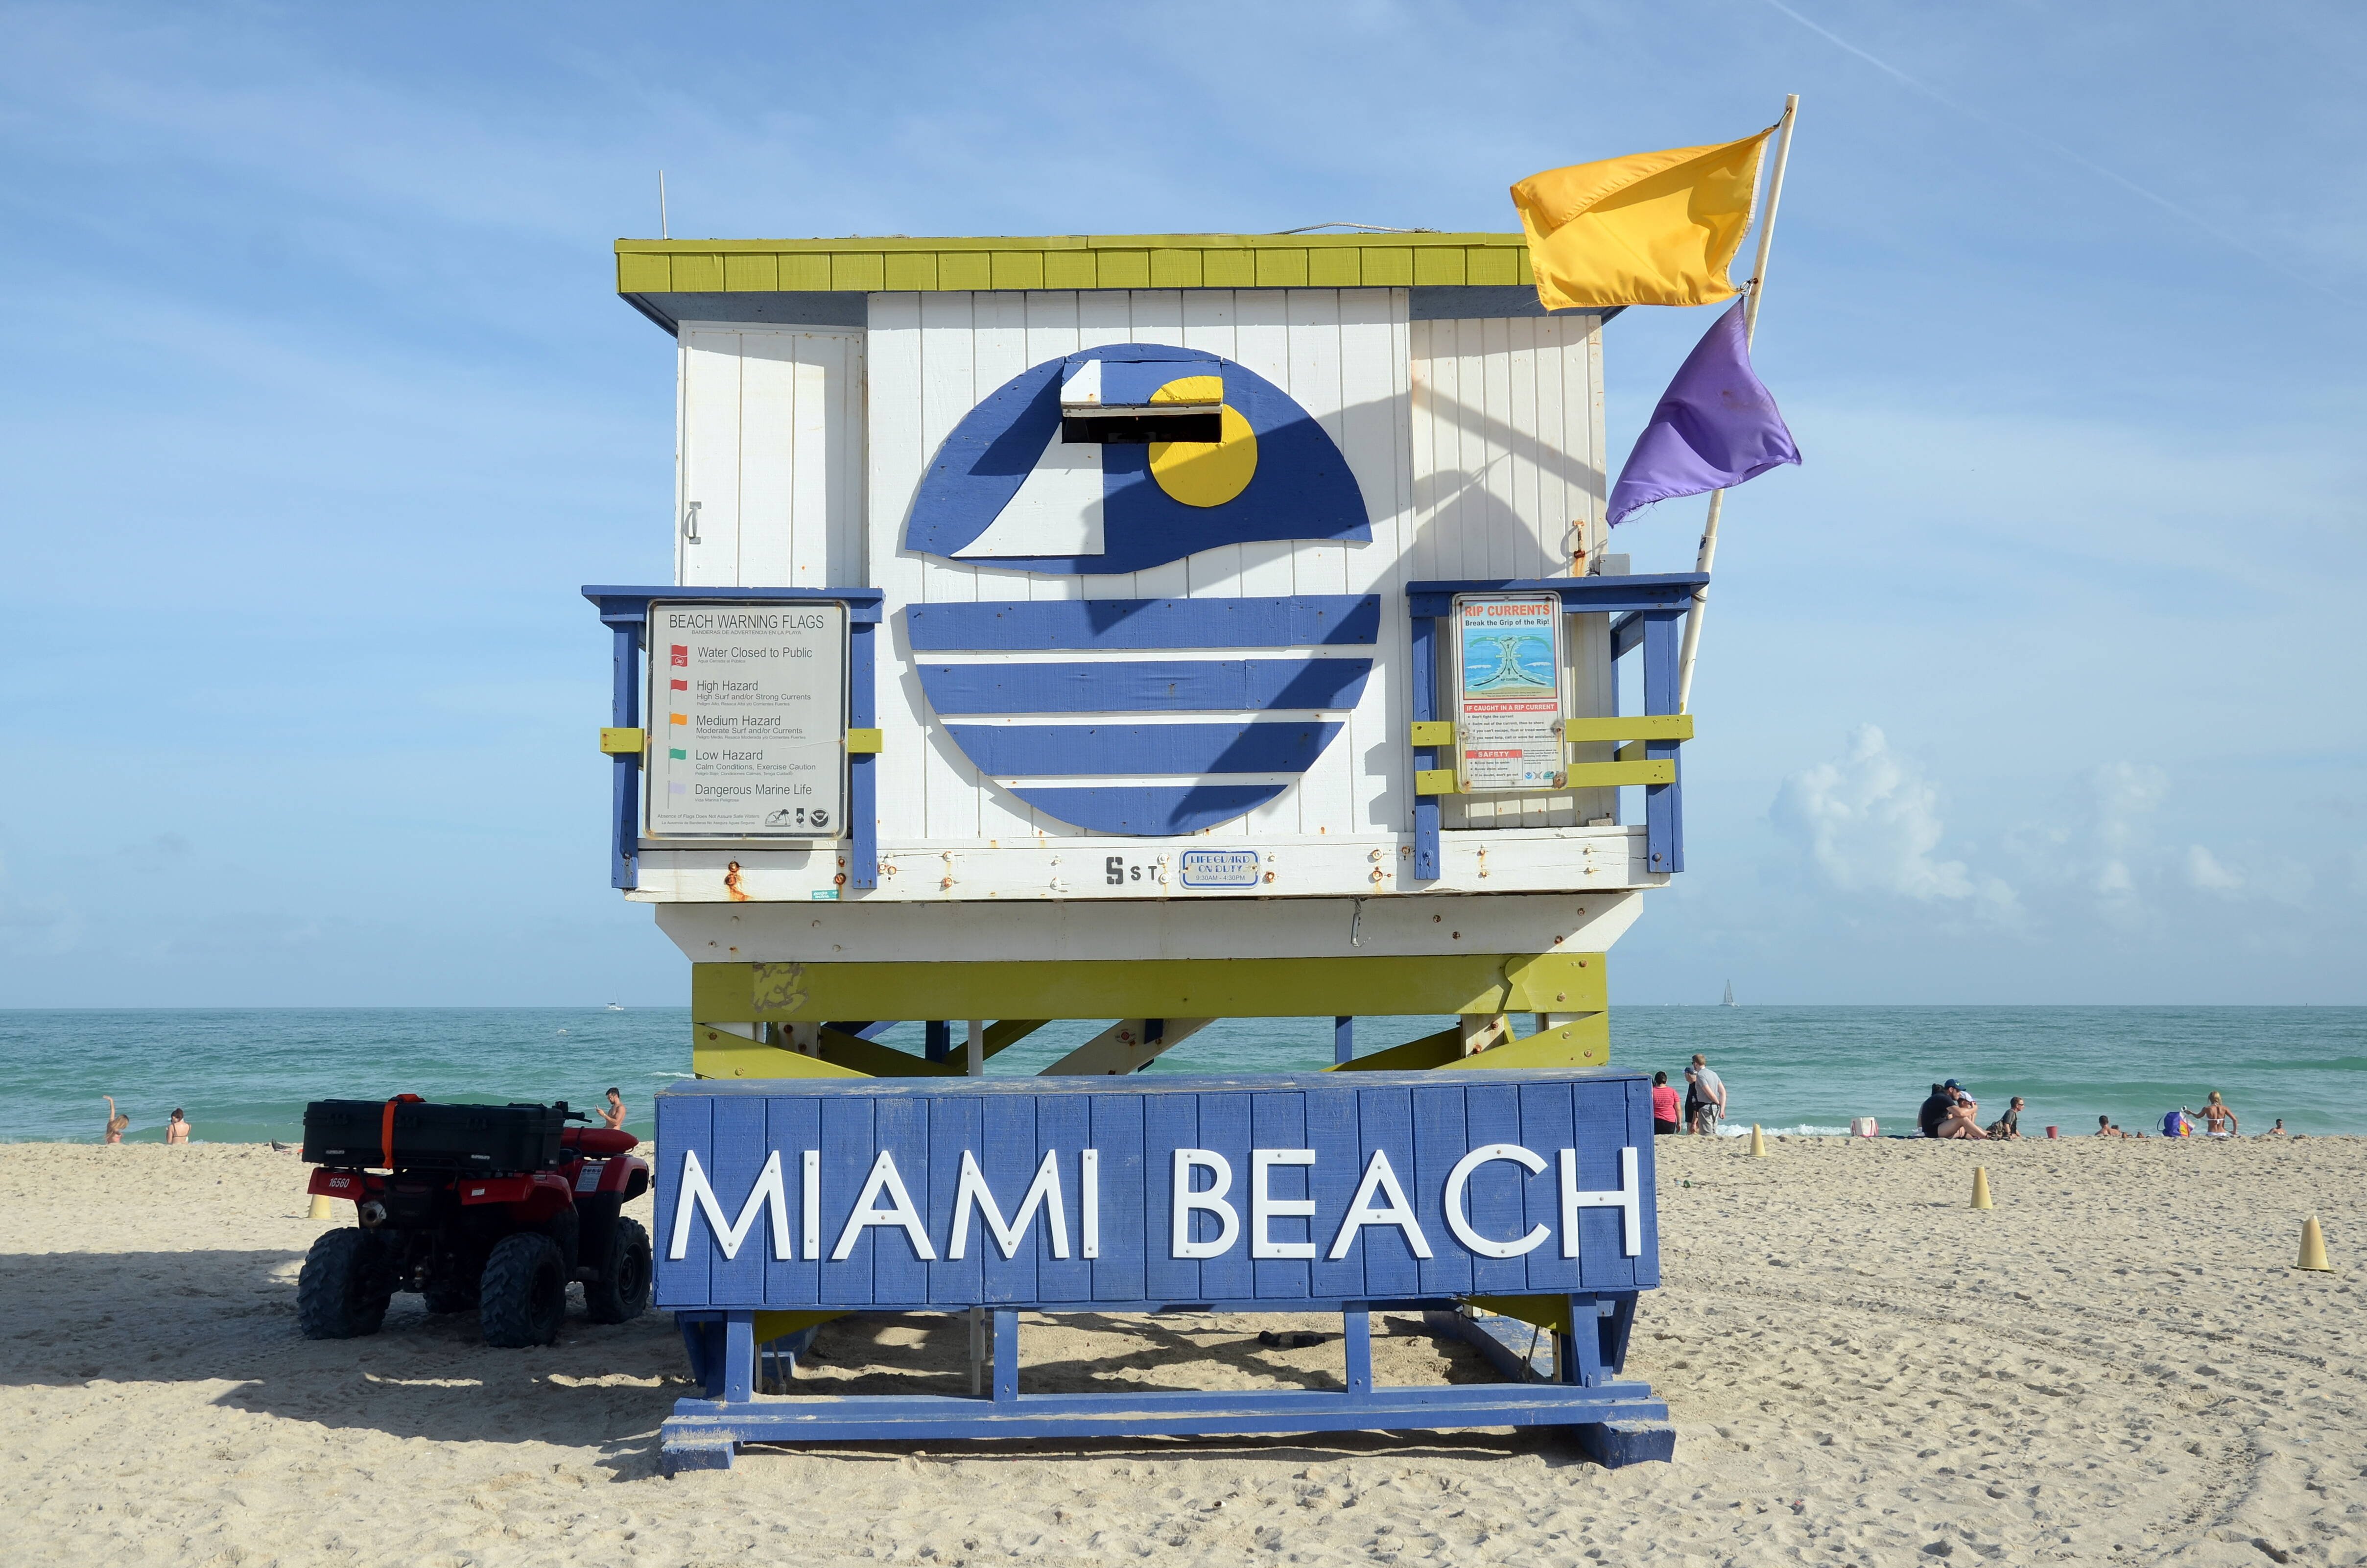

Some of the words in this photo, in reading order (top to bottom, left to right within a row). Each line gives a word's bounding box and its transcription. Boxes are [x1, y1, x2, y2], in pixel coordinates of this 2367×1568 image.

[1465, 606, 1484, 617] RIP
[1487, 604, 1550, 616] CURRENTS
[670, 615, 712, 628] BEACH
[718, 615, 777, 628] WARNING
[782, 615, 823, 629] FLAGS
[698, 647, 727, 658] Water
[731, 647, 766, 658] Closed
[770, 648, 779, 658] to
[783, 647, 812, 658] Public
[697, 680, 718, 693] High
[723, 680, 758, 690] Hazard
[697, 715, 737, 725] Medium
[742, 715, 781, 726] Hazard
[696, 750, 718, 760] Low
[723, 750, 763, 760] Hazard
[695, 784, 751, 797] Dangerous
[756, 784, 790, 795] Marine
[794, 784, 812, 795] Life
[329, 1178, 350, 1188] 16560
[668, 1147, 1100, 1261] MIAMI
[1173, 1143, 1642, 1261] BEACH
